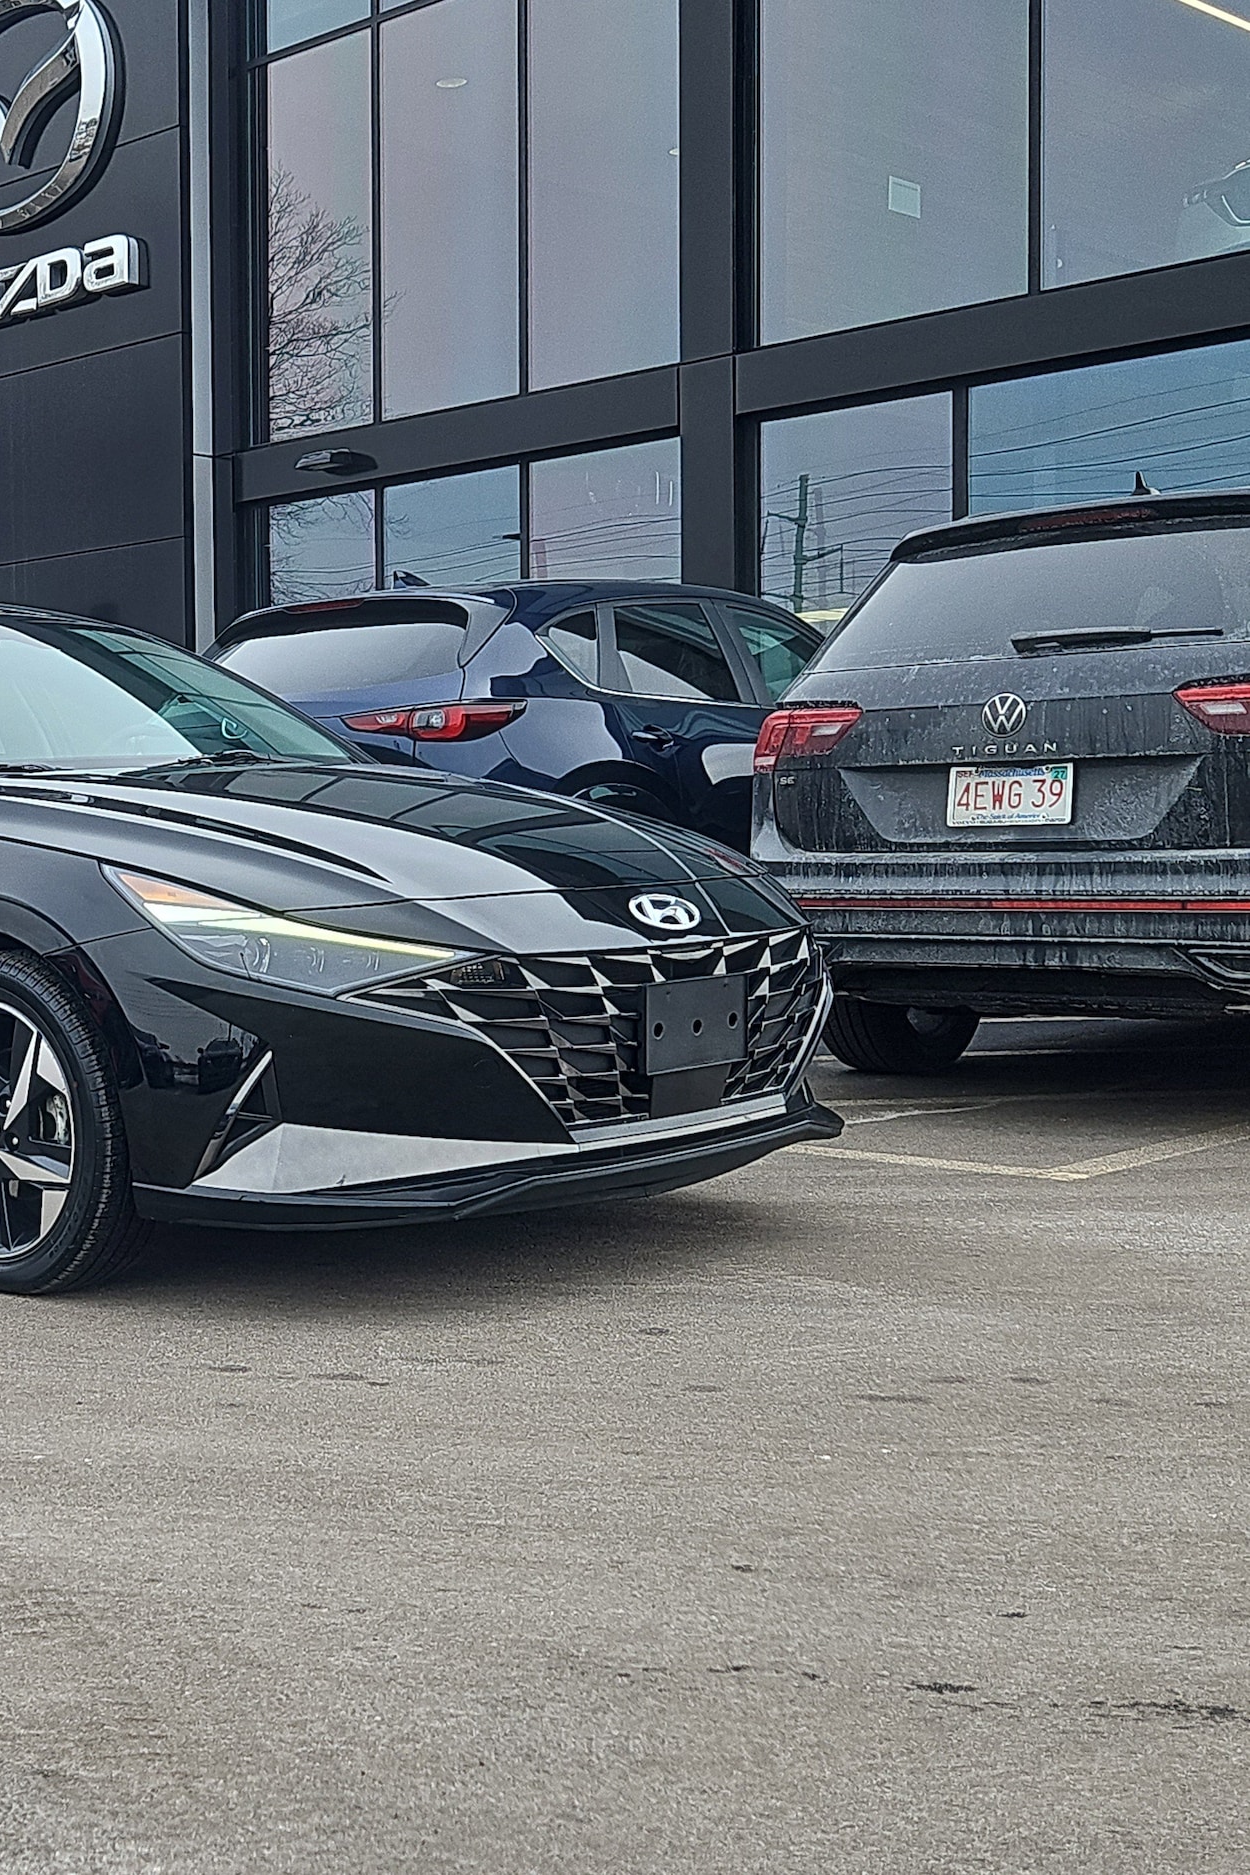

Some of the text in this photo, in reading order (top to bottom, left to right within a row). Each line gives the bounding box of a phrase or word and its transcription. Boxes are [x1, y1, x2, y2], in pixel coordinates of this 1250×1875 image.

[952, 742, 1057, 756] TIGUAN
[1053, 770, 1066, 779] 27
[780, 776, 795, 785] SE
[957, 779, 1064, 811] 4EWG 39
